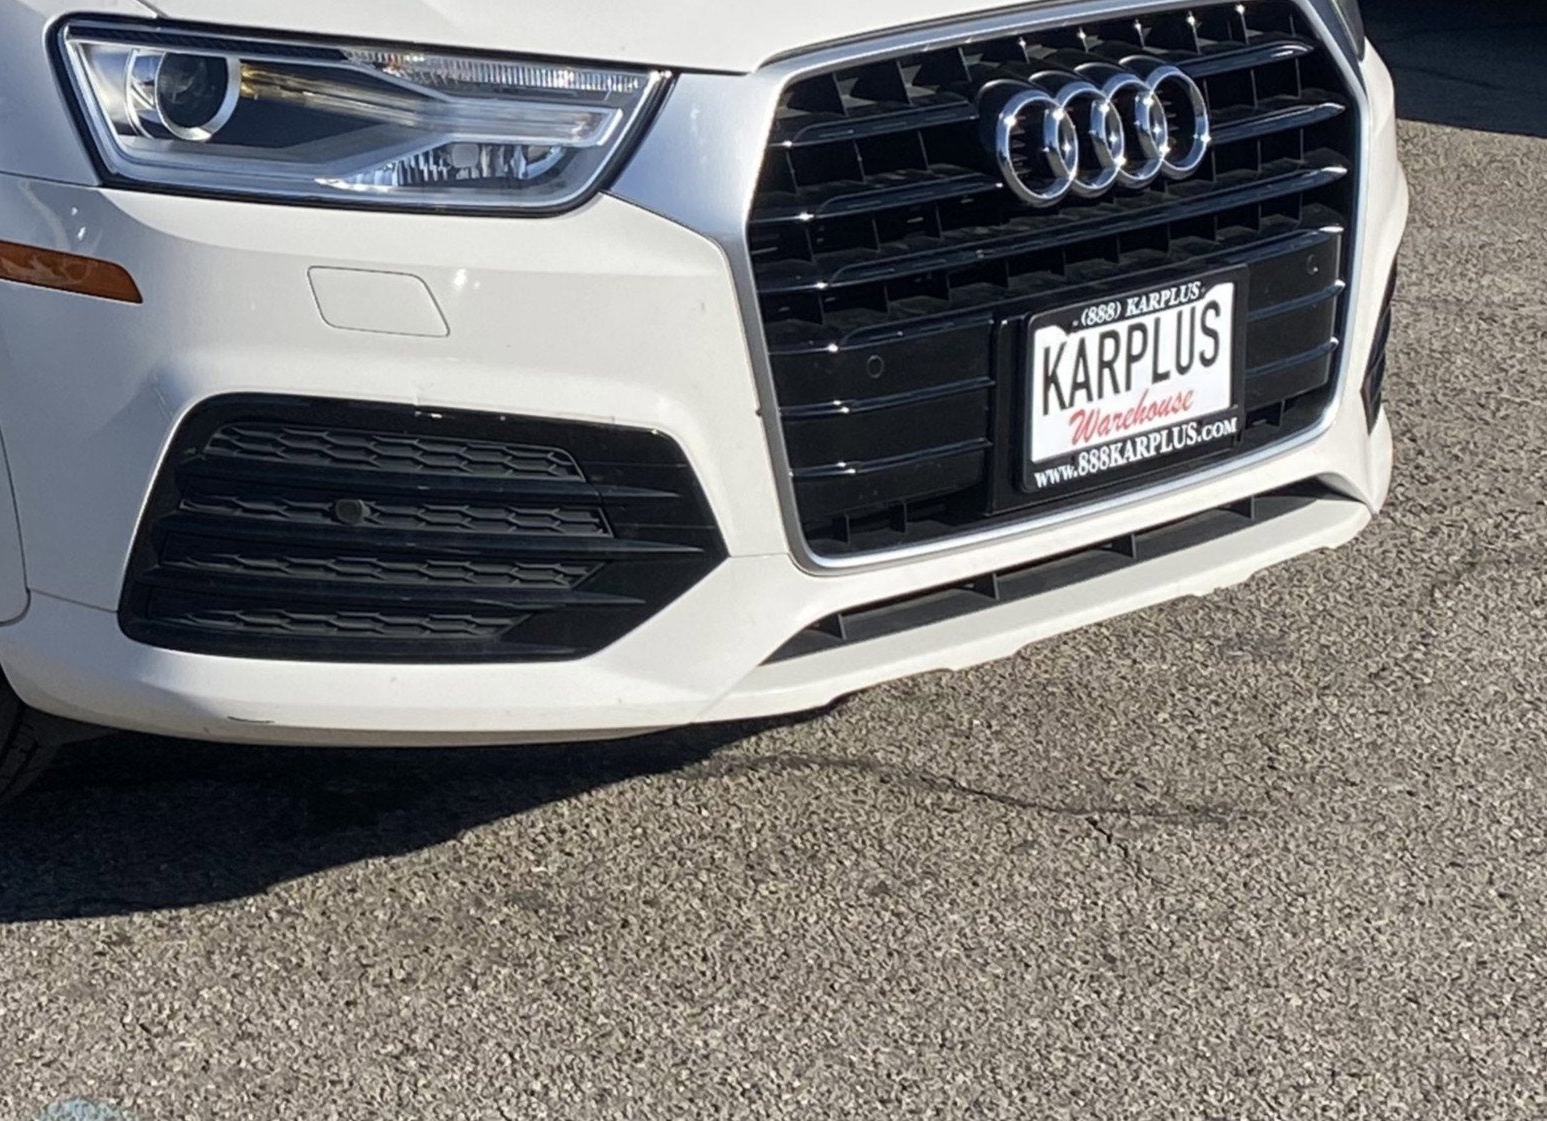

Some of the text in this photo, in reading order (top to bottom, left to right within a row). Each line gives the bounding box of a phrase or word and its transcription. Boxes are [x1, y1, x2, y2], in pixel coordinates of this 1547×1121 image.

[1080, 281, 1202, 327] (888) KARPLUS
[1043, 299, 1221, 416] KARPLUS
[1068, 388, 1194, 447] Warehouse
